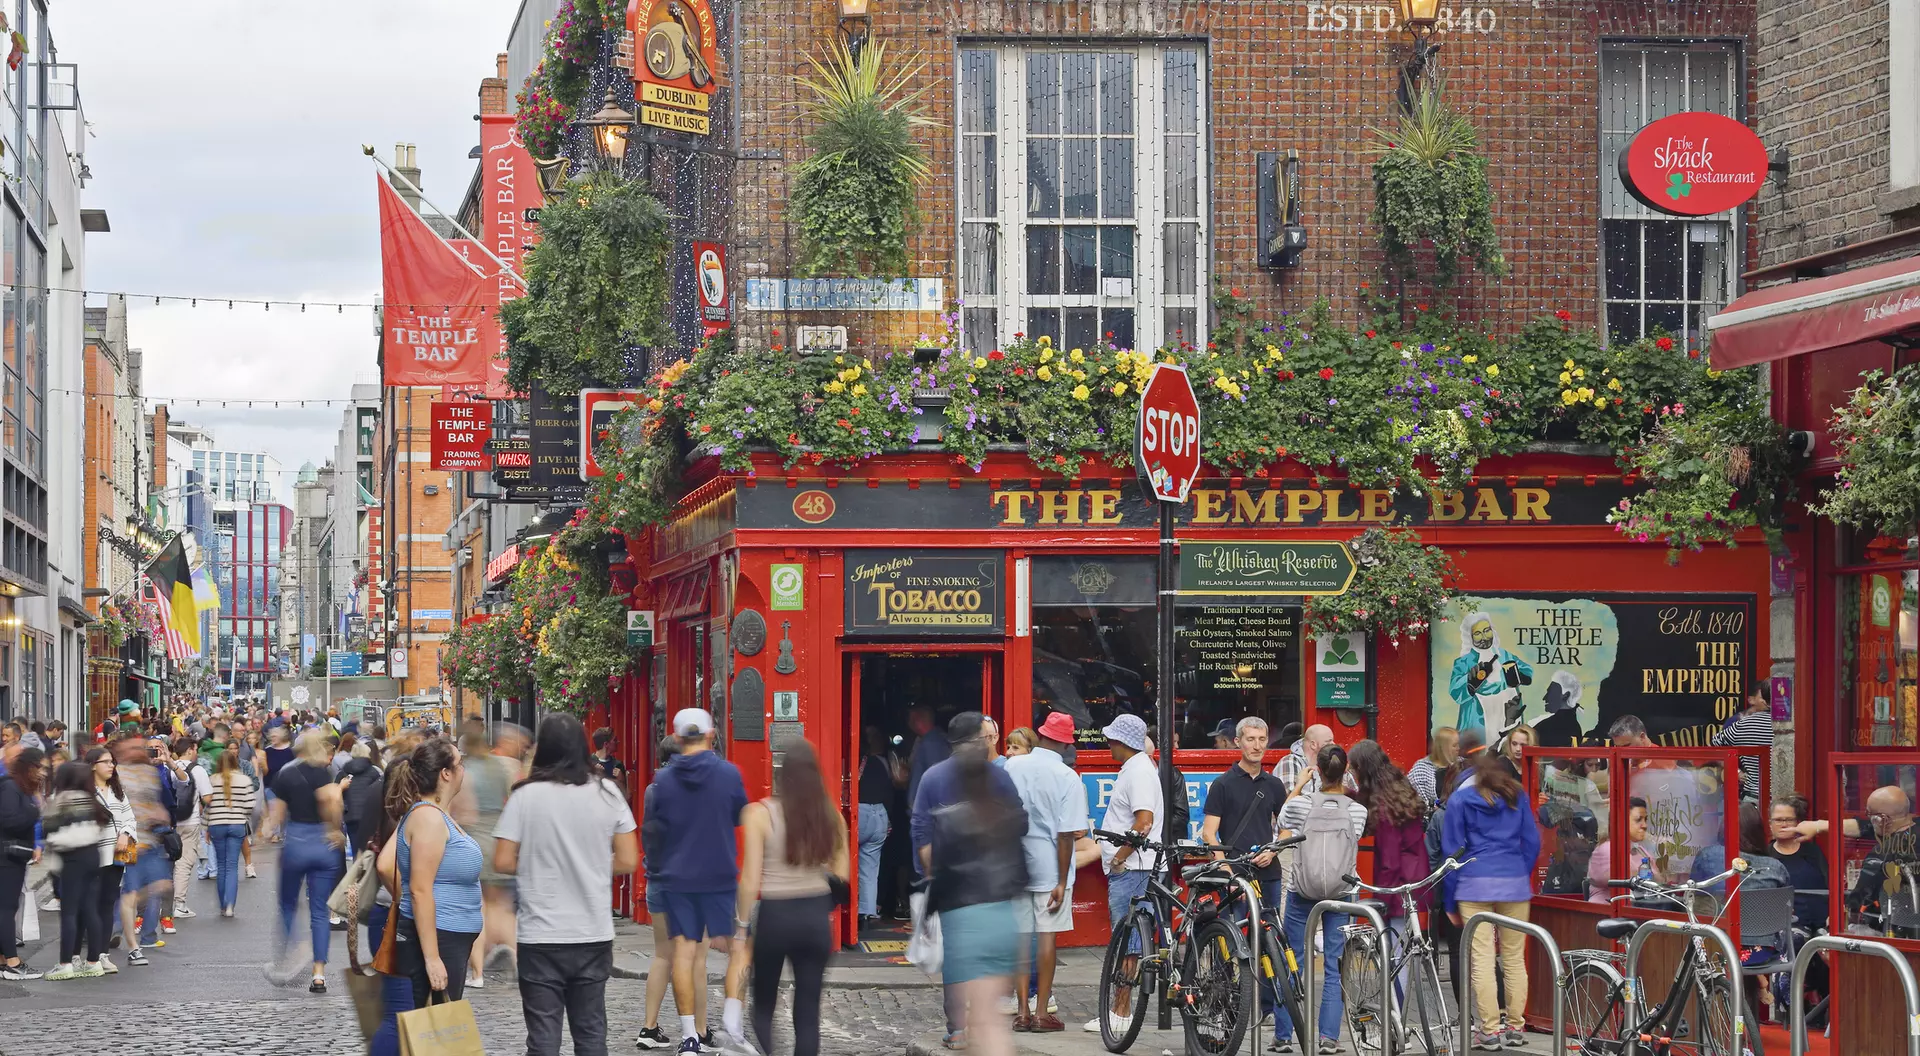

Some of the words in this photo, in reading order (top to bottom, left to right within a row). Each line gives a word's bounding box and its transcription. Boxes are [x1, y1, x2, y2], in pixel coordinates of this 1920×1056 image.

[698, 7, 713, 48] BAR
[1422, 7, 1497, 34] 840
[656, 88, 696, 106] DUBLIN
[648, 110, 671, 125] LIVE
[673, 115, 704, 131] MUSIC
[1674, 135, 1694, 150] The
[1654, 137, 1714, 172] Shack
[496, 156, 514, 204] BAR
[1686, 170, 1756, 184] Restaurant
[872, 296, 912, 306] SOUTH
[417, 316, 452, 328] THE
[392, 328, 478, 344] TEMPLE
[414, 346, 458, 360] BAR
[450, 408, 474, 418] THE
[438, 420, 486, 430] TEMPLE
[1144, 406, 1196, 458] STOP
[448, 432, 474, 443] BAR
[490, 440, 510, 448] THE
[538, 456, 561, 464] LIVE
[800, 494, 826, 516] 48
[992, 490, 1124, 526] THE
[1157, 490, 1398, 524] EMPLE
[1427, 488, 1552, 522] BAR
[850, 556, 914, 582] Importers
[1194, 553, 1213, 569] The
[1213, 546, 1280, 576] Whiskey
[1281, 549, 1338, 576] Reserve
[906, 577, 930, 586] FINE
[932, 577, 980, 586] SMOKING
[867, 582, 982, 620] TOBACCO
[890, 614, 934, 624] Always
[940, 614, 951, 623] in
[956, 614, 990, 623] Stock
[1216, 618, 1237, 626] Plate,
[1536, 608, 1582, 627] THE
[1658, 606, 1703, 635] Estb.
[1707, 611, 1744, 635] 1840
[1203, 630, 1234, 638] Oysters,
[1513, 627, 1602, 646] TEMPLE
[1236, 640, 1260, 649] Meats,
[1696, 642, 1740, 666] THE
[1536, 646, 1583, 666] BAR
[1642, 668, 1741, 694] EMPEROR
[1714, 697, 1740, 721] OF
